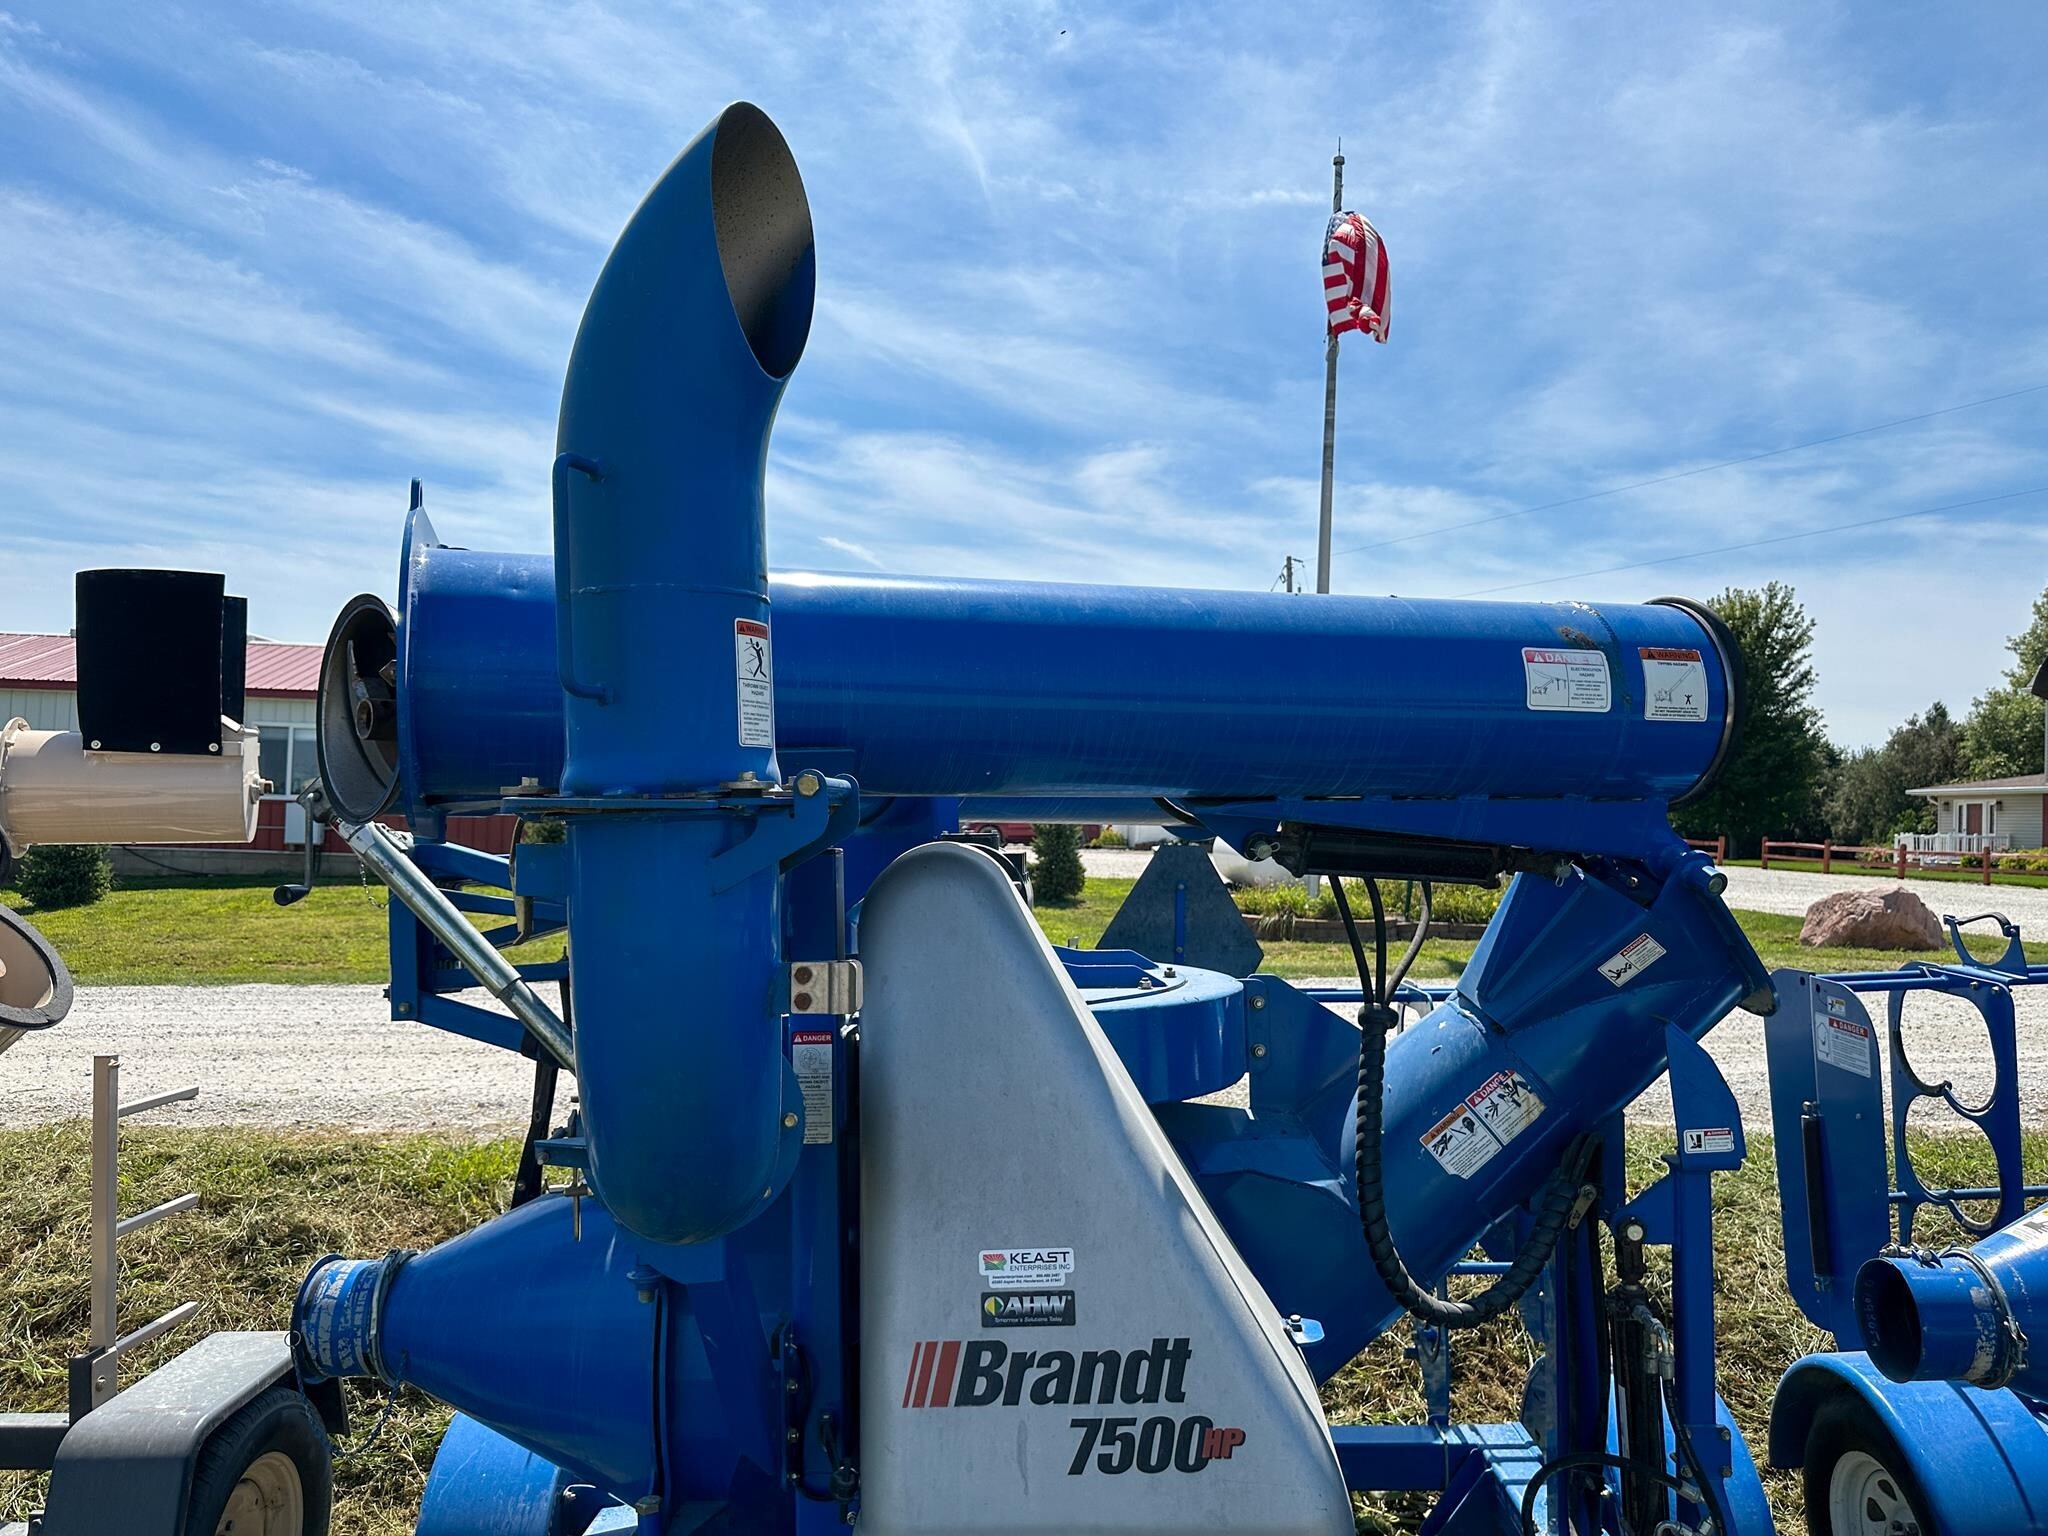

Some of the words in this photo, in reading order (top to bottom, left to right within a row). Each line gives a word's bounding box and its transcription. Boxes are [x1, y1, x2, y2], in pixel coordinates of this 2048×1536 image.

[1656, 651, 1695, 659] WARNING
[1839, 1021, 1865, 1036] DANGER
[1010, 1251, 1070, 1264] KEAST
[1003, 1295, 1067, 1316] AHW
[954, 1337, 1192, 1407] Brandt
